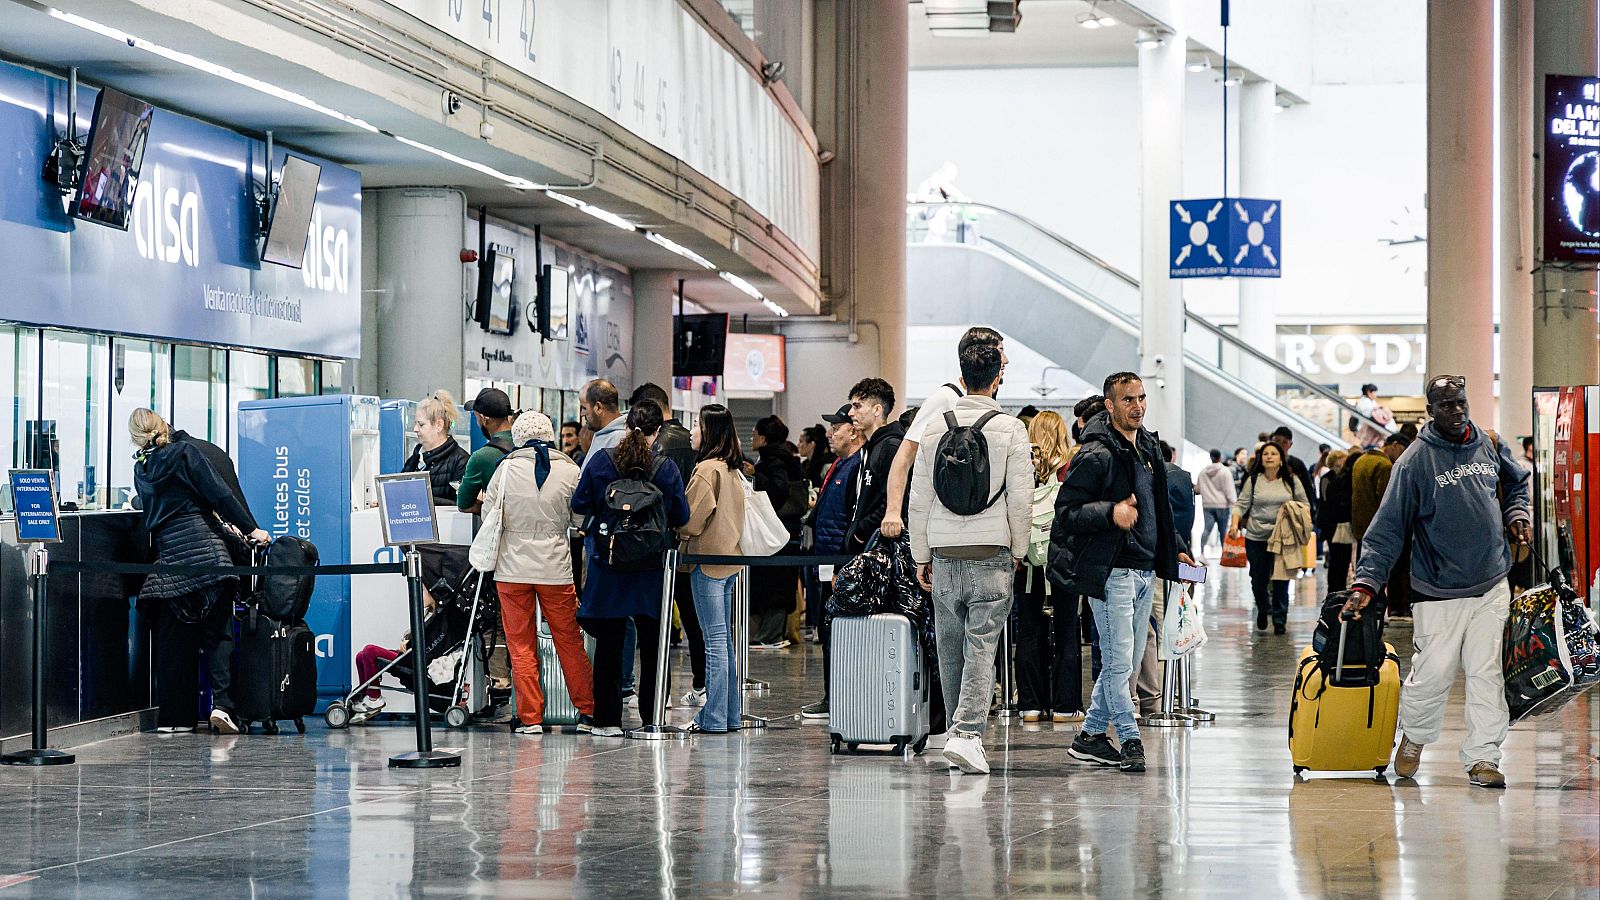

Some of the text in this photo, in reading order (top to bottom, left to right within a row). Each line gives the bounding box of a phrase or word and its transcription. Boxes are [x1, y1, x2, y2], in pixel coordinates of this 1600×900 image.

[520, 0, 536, 63] 42
[610, 47, 622, 111] 43
[633, 61, 645, 125] 44
[656, 77, 667, 138] 45
[1552, 117, 1578, 135] DEL
[1566, 103, 1585, 120] LA
[134, 163, 200, 268] alsa
[302, 206, 349, 294] alsa
[203, 283, 226, 312] Venta
[226, 287, 255, 315] nacional
[272, 446, 289, 541] illetes bus
[294, 468, 310, 516] sales
[425, 632, 446, 654] CLAREN
[1505, 633, 1546, 669] NA
